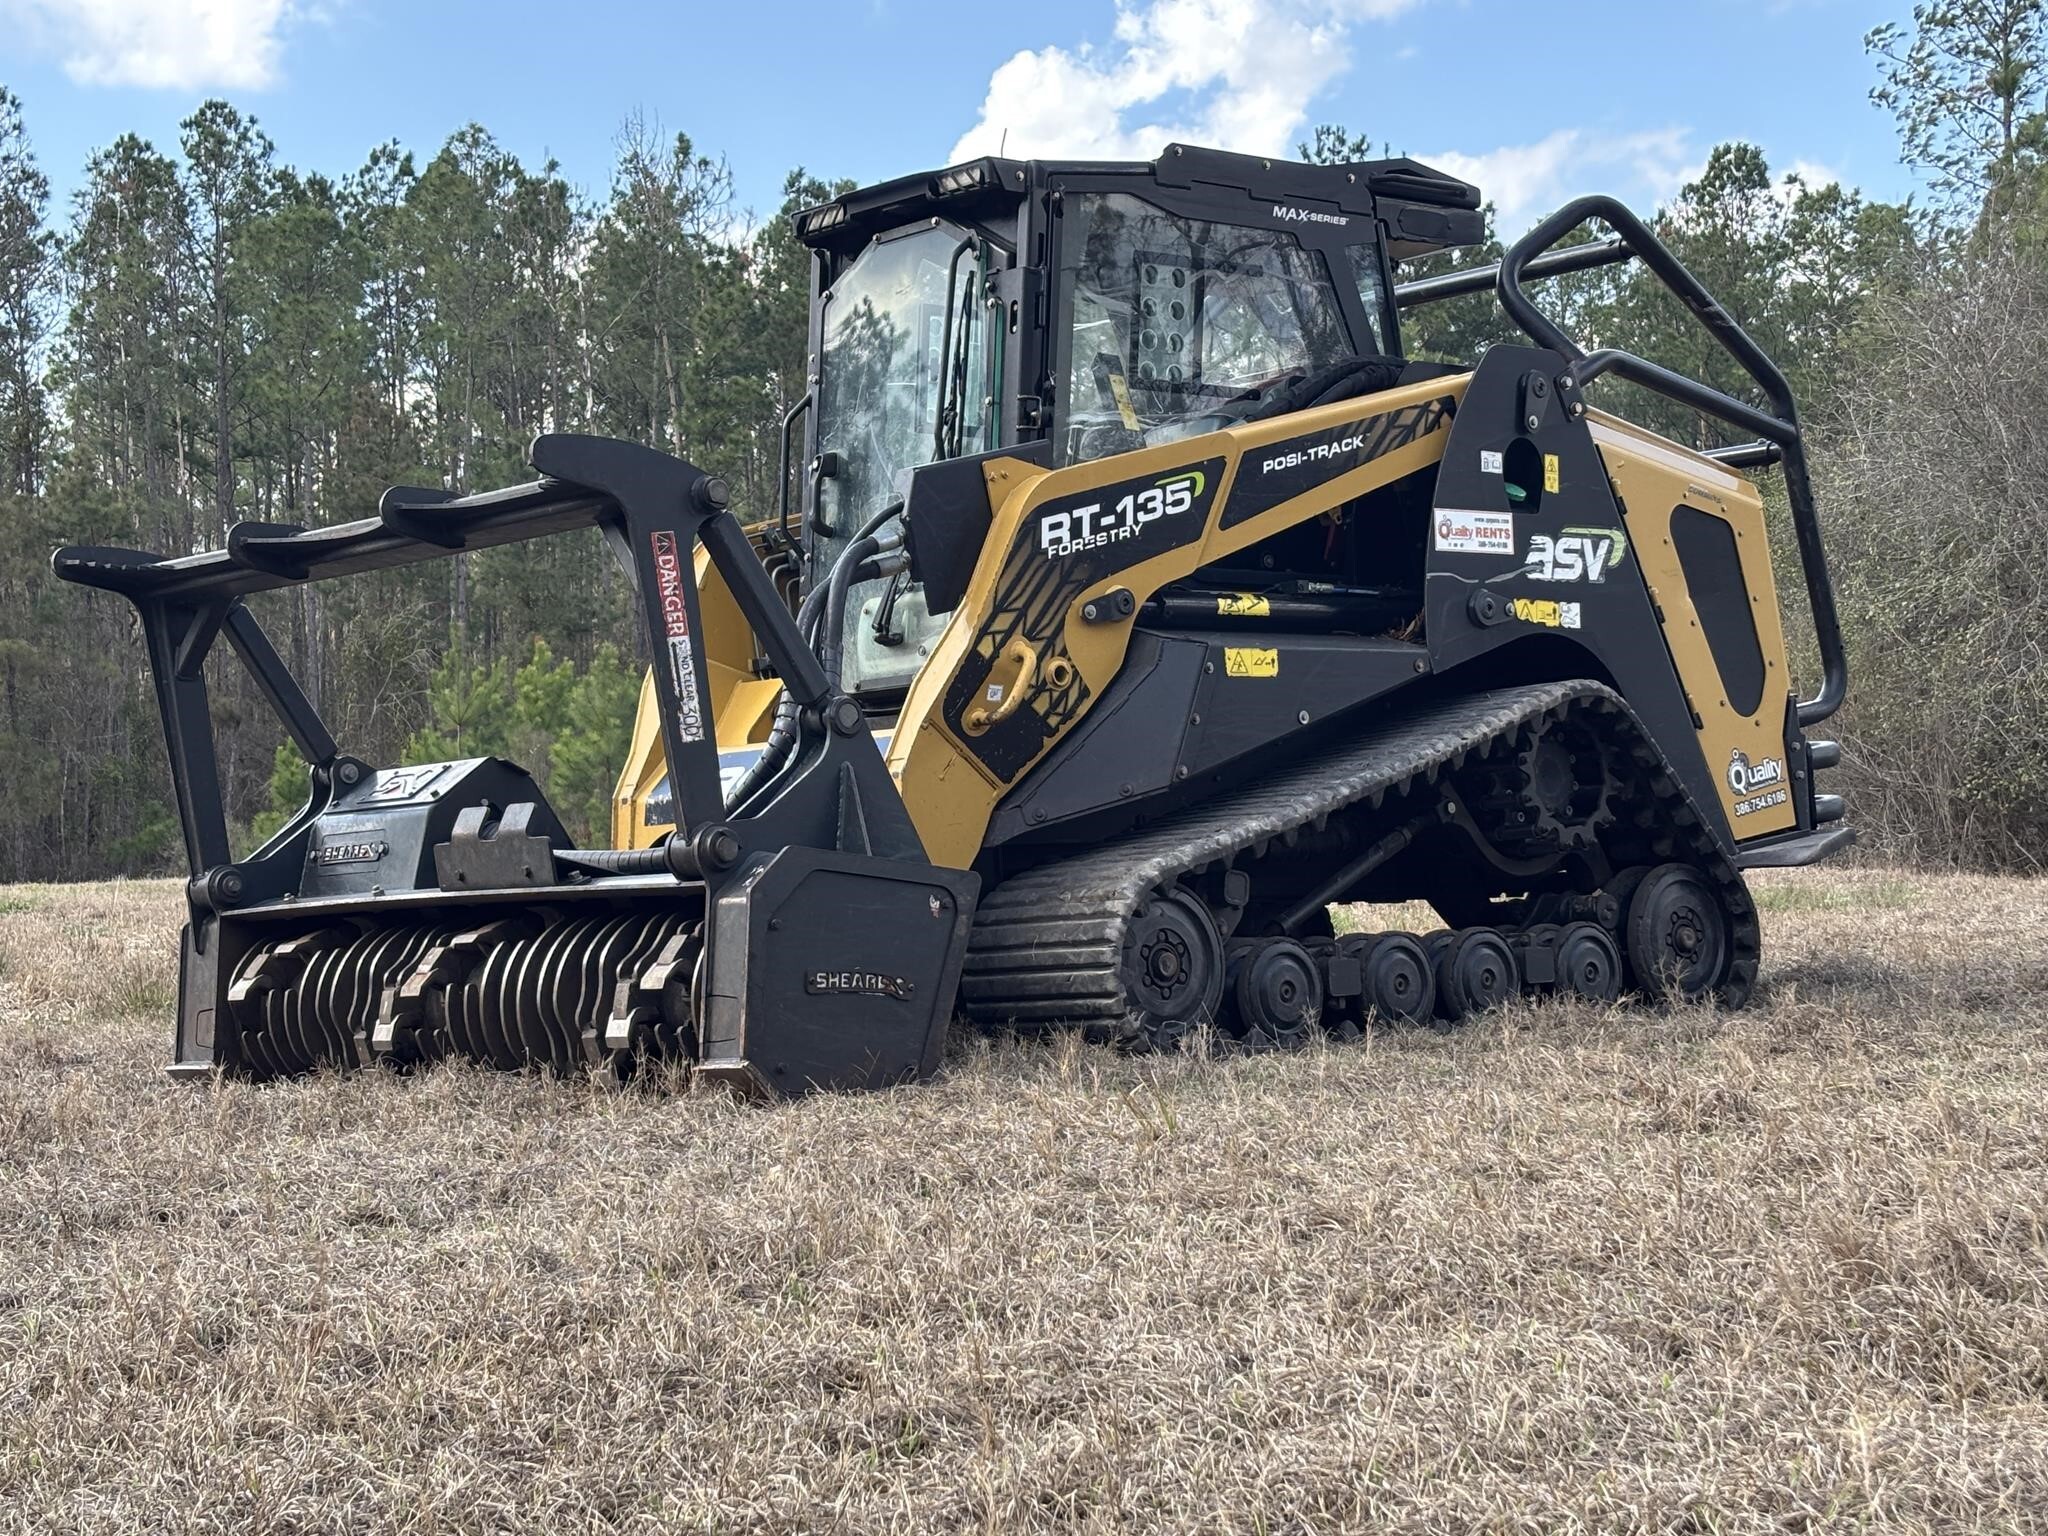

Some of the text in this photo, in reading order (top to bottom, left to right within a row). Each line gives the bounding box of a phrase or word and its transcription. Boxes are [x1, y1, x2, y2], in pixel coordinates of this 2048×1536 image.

[1263, 434, 1364, 474] POSI-TRACK
[1041, 479, 1192, 549] RT-135
[1048, 522, 1144, 559] FORESTRY
[1475, 527, 1511, 539] RENTS
[658, 555, 685, 635] DANGER
[678, 640, 691, 670] SND
[1730, 759, 1782, 795] Quality
